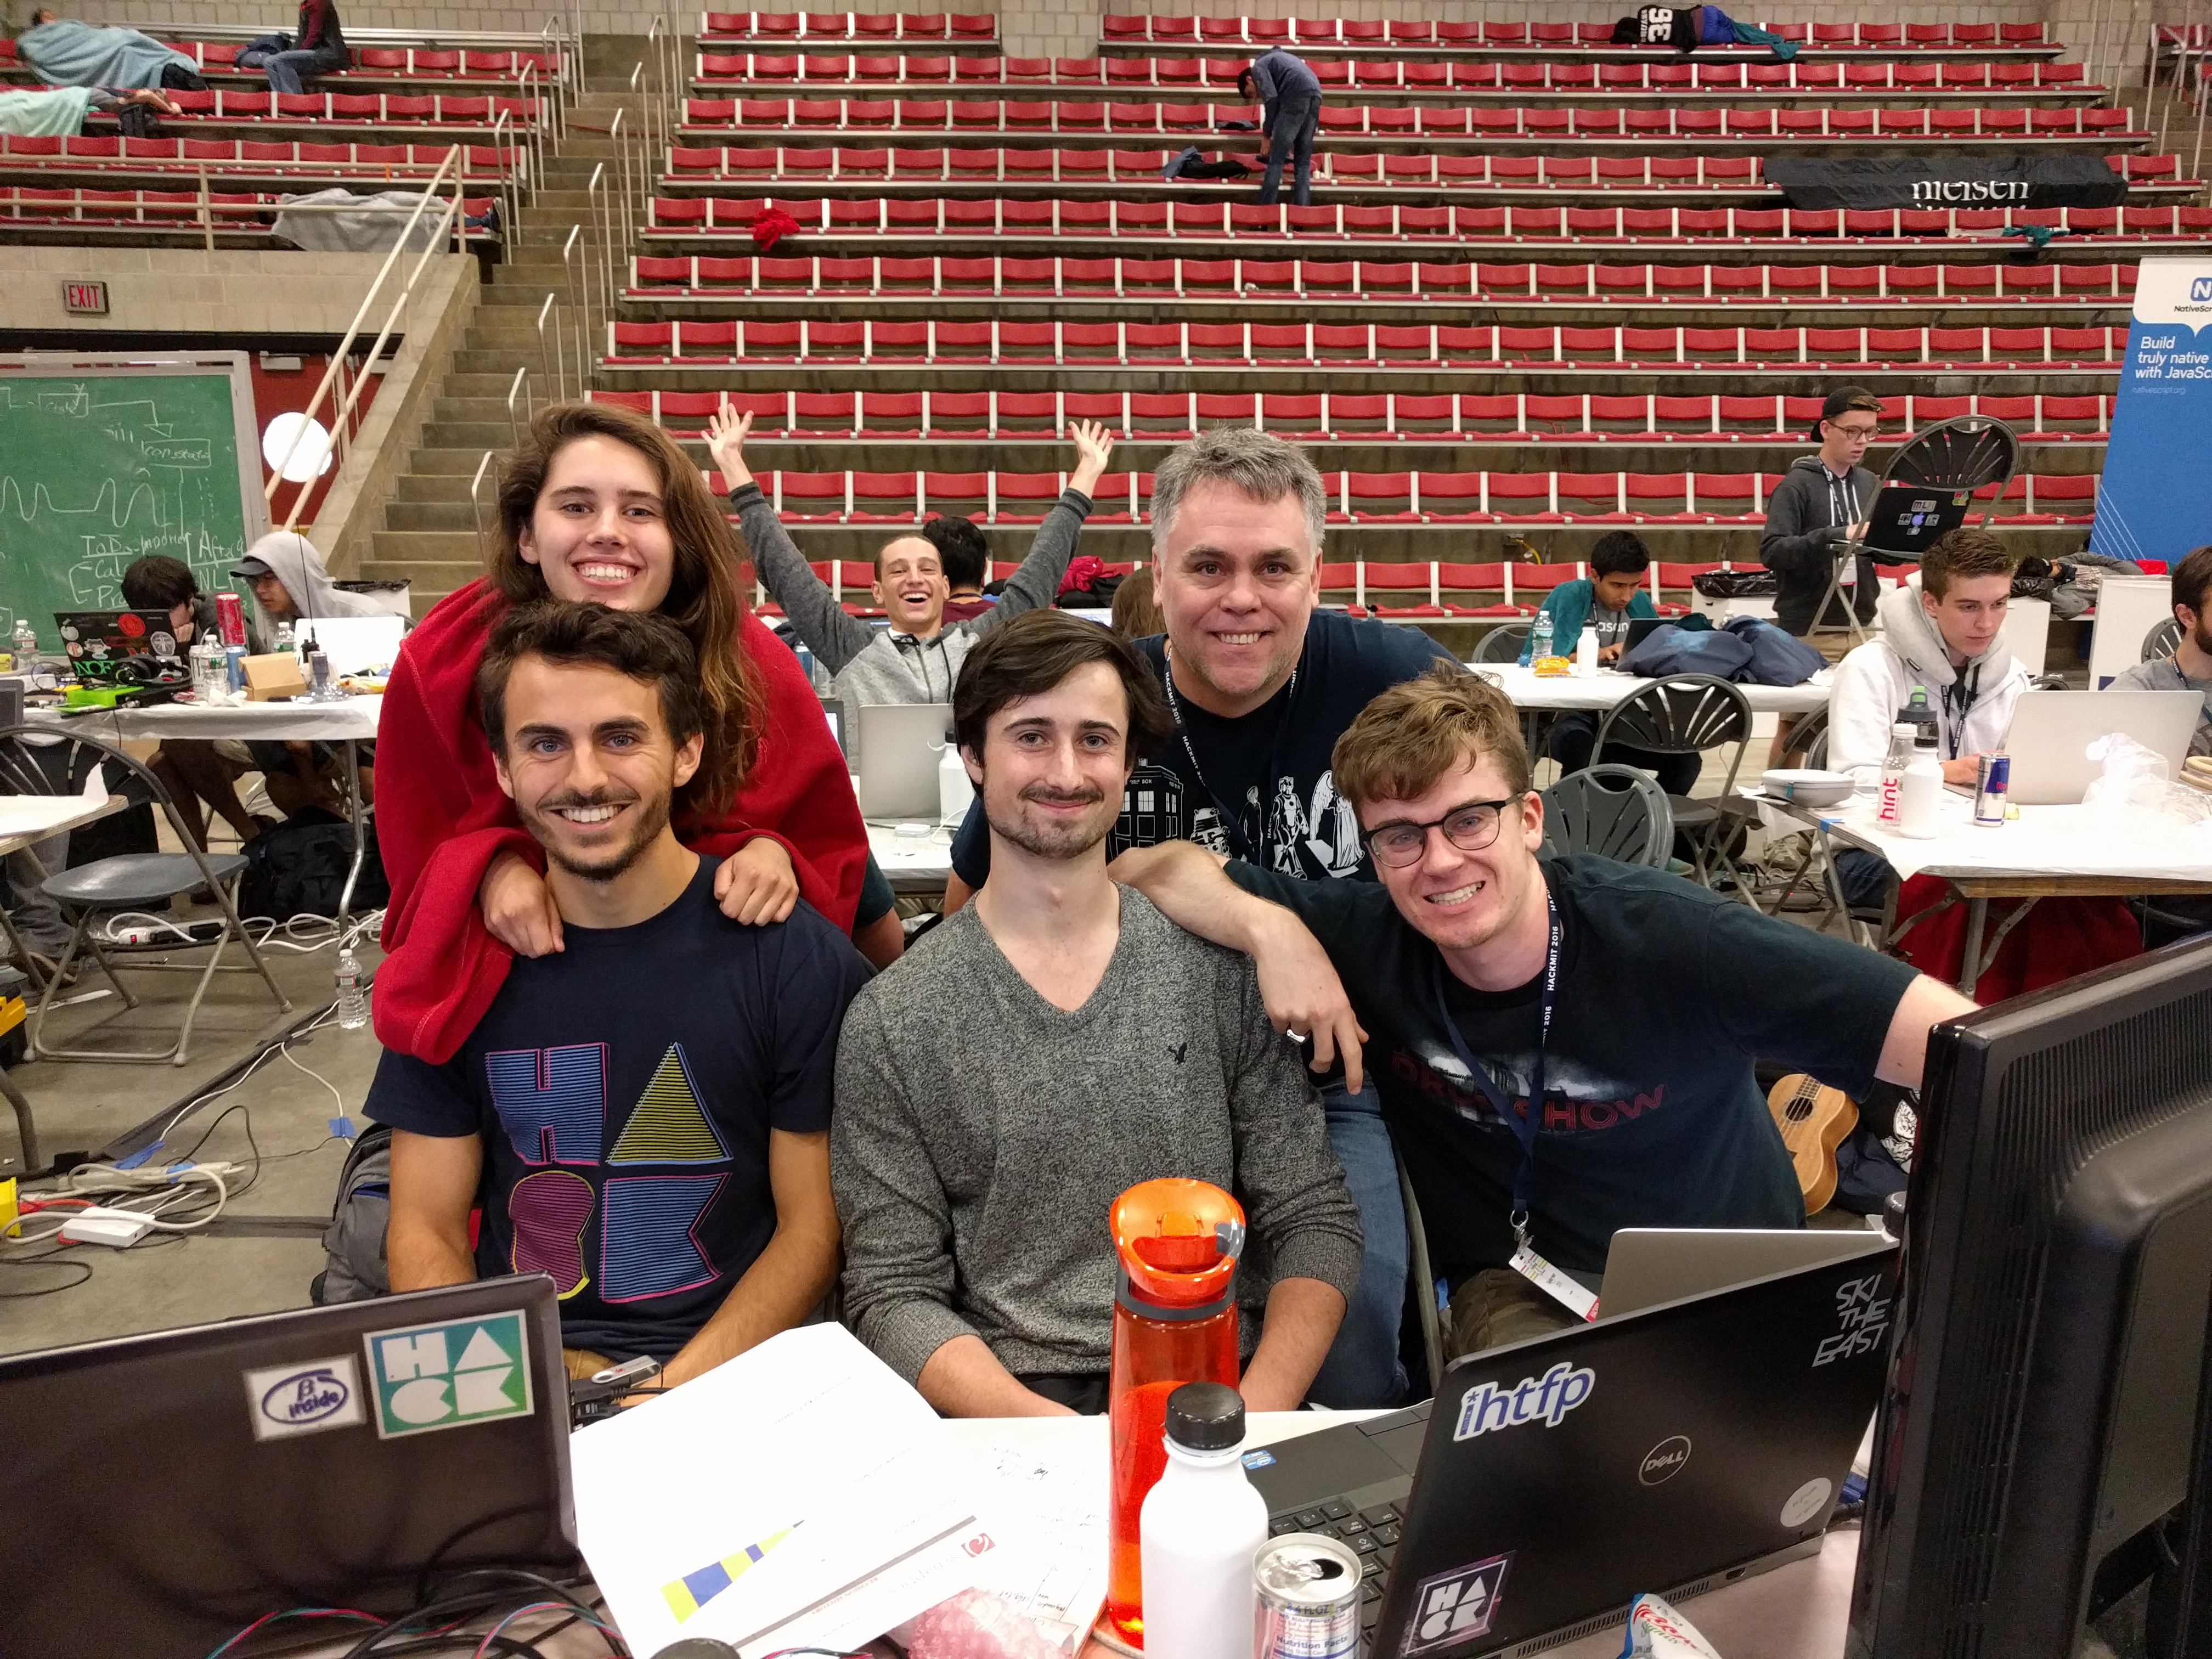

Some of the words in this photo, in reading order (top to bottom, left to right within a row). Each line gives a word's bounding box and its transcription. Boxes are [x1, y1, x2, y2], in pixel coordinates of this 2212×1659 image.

[1648, 8, 1673, 42] 36
[69, 285, 99, 308] EXIT
[2141, 336, 2176, 349] Build
[2135, 366, 2162, 379] with
[2165, 366, 2212, 379] JavaSc
[2138, 351, 2168, 366] truly
[2170, 352, 2209, 364] native
[1165, 672, 1176, 707] HACKMIT
[1172, 706, 1182, 725] 2016
[1182, 735, 1199, 770] HACKMIT
[1880, 777, 1898, 820] hint
[1547, 949, 1558, 991] HACKMIT
[1544, 1006, 1552, 1026] 2016
[1836, 1273, 1882, 1310] SKI
[1839, 1298, 1891, 1329] THE
[1812, 1322, 1889, 1367] EAST
[289, 1390, 339, 1418] inside
[1459, 1367, 1590, 1437] ihtfp
[1645, 1450, 1684, 1471] DELL
[845, 1577, 878, 1595] REVISION
[812, 1594, 845, 1615] HISTORY
[1276, 1634, 1321, 1649] Nutrition
[1324, 1635, 1348, 1648] Facts
